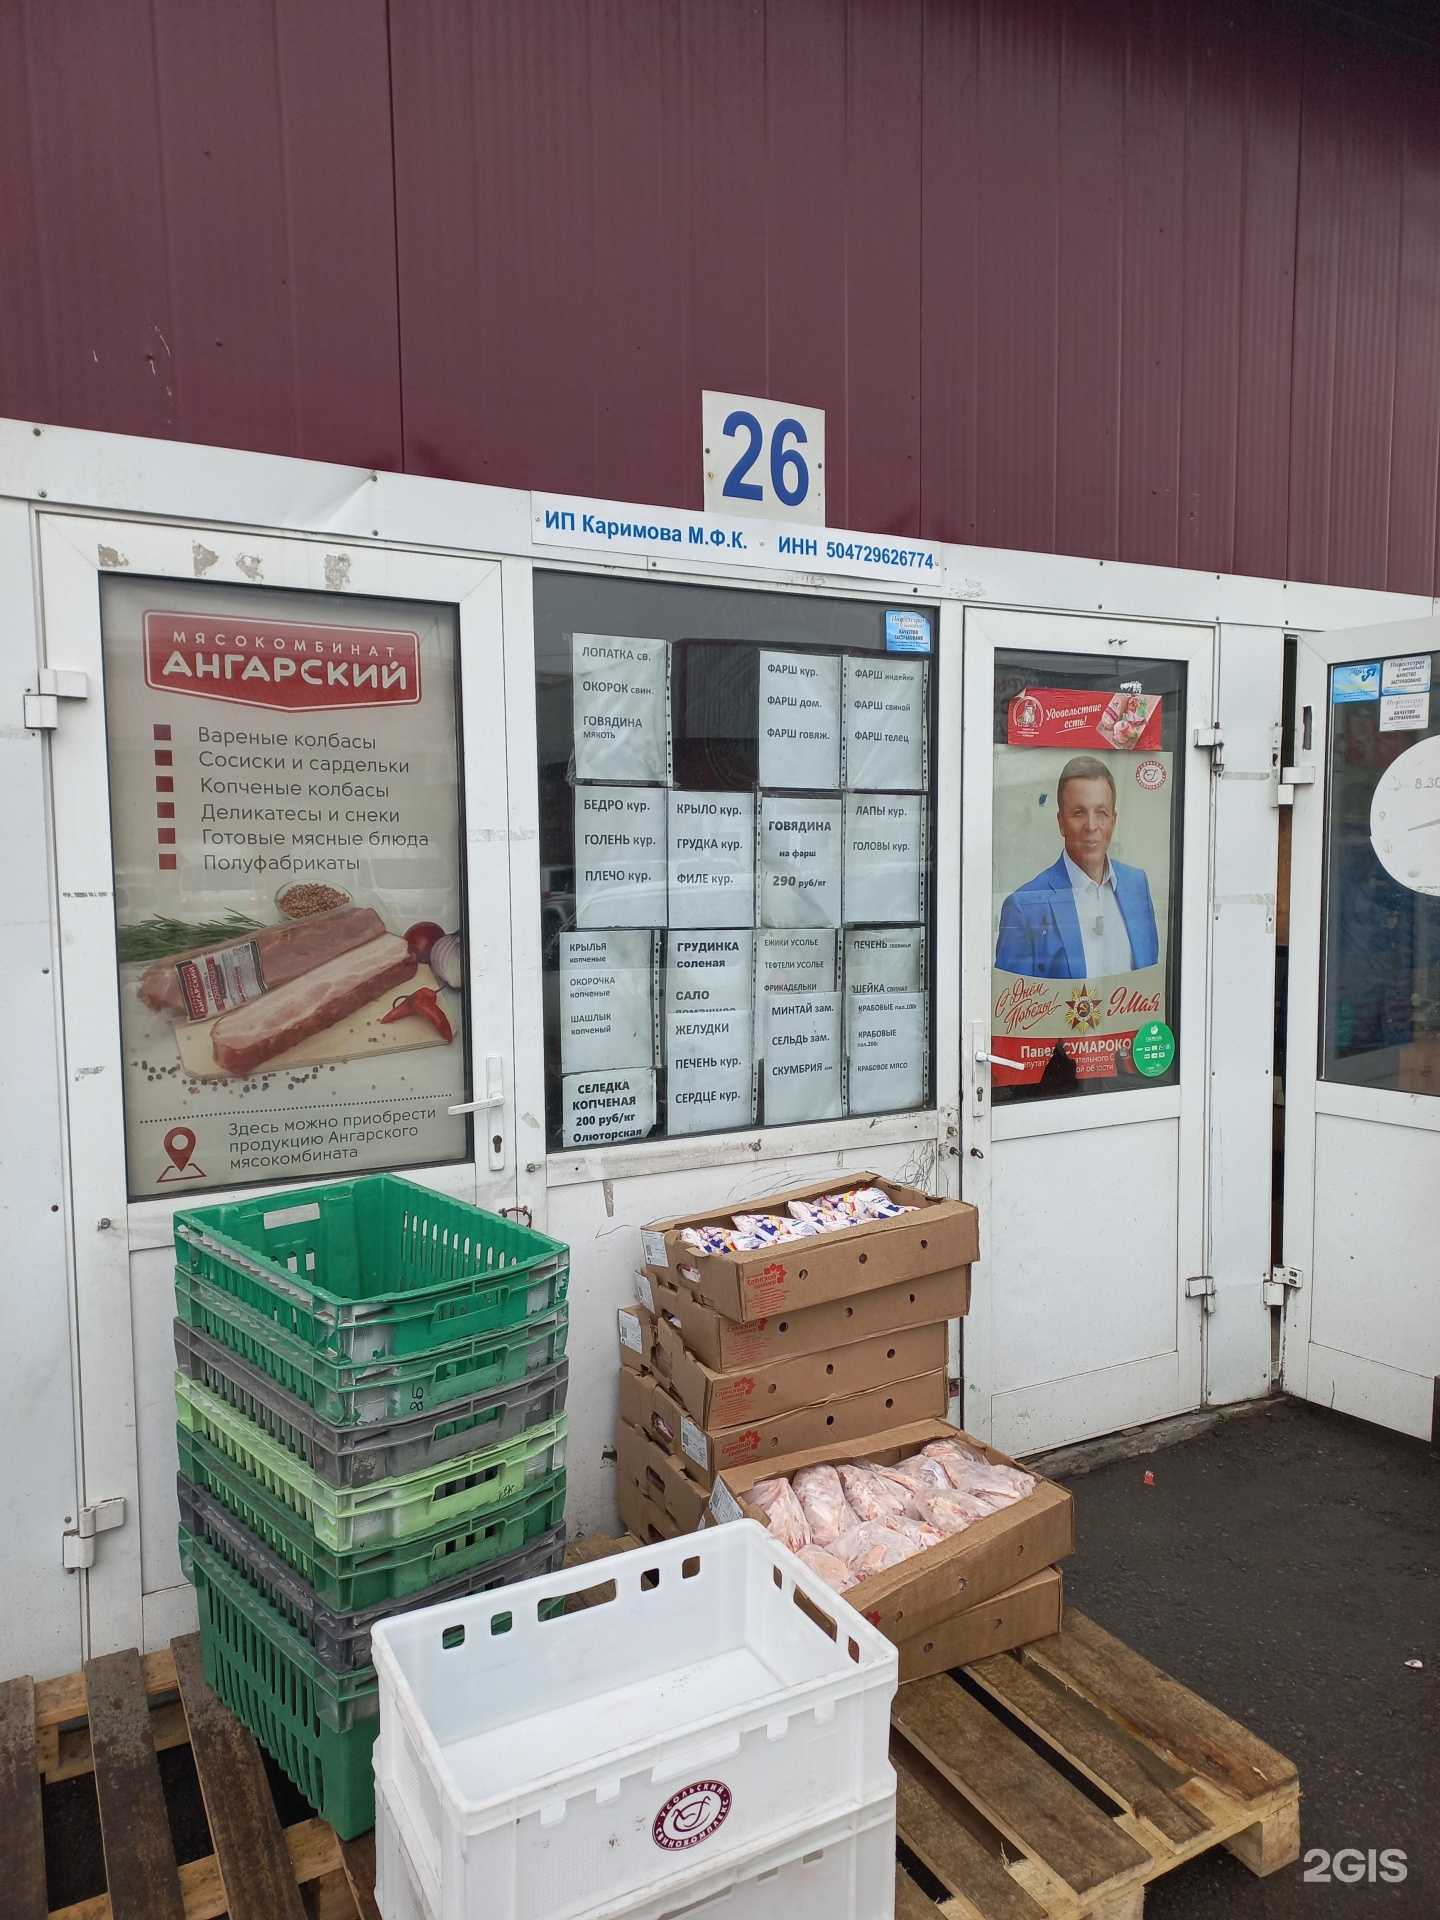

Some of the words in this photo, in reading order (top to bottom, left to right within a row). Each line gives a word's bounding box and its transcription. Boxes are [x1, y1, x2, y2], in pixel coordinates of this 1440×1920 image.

[722, 410, 809, 507] 26
[545, 510, 575, 531] ИП
[582, 513, 682, 544] Каримова
[688, 525, 748, 550] М.Ф.К.
[778, 536, 817, 557] ИНН
[826, 541, 934, 569] 504729626774
[173, 631, 395, 658] МЯСОКОМБИНАТ
[582, 647, 634, 660] ЛОПАТКА
[162, 650, 407, 690] АНГАРСКИЙ
[767, 663, 798, 674] ФАРШ
[800, 668, 818, 678] кур.
[854, 669, 883, 680] ФАРШ
[583, 681, 628, 694] ОКОРОК
[630, 687, 655, 695] свин.
[767, 696, 797, 707] ФАРШ
[799, 701, 822, 709] дом.
[854, 700, 883, 710] ФАРШ
[583, 716, 643, 729] ГОВЯДИНА
[198, 726, 288, 748] Вареные
[294, 733, 376, 750] колбасы
[583, 731, 616, 740] мякоть
[767, 728, 797, 739] ФАРШ
[799, 732, 831, 740] говяж.
[854, 730, 882, 741] ФАРШ
[884, 735, 910, 744] телец
[199, 751, 285, 769] Сосиски
[292, 757, 303, 770] и
[309, 758, 409, 774] сардельки
[201, 777, 301, 796] Копченые
[308, 781, 389, 798] колбасы
[583, 800, 623, 812] БЕДРО
[626, 802, 650, 813] кур.
[676, 803, 717, 815] КРЫЛО
[720, 806, 742, 817] кур.
[856, 806, 886, 816] ЛАПЫ
[888, 808, 908, 818] кур.
[201, 804, 322, 824] Деликатесы
[328, 810, 339, 822] и
[345, 809, 400, 823] снеки
[768, 821, 832, 834] ГОВЯДИНА
[202, 829, 285, 846] Готовые
[292, 832, 363, 847] мясные
[368, 831, 429, 849] блюда
[584, 834, 630, 845] ГОЛЕНЬ
[633, 836, 656, 848] кур.
[677, 838, 718, 851] ГРУДКА
[721, 840, 743, 851] кур.
[853, 841, 890, 851] ГОЛОВЫ
[892, 843, 910, 852] кур.
[792, 849, 817, 859] фарш
[204, 854, 360, 875] Полуфабрикаты
[585, 870, 625, 881] ПЛЕЧО
[628, 872, 651, 883] кур.
[677, 873, 709, 884] ФИЛЕ
[711, 875, 734, 886] кур.
[772, 875, 796, 887] 290
[798, 879, 827, 889] руб/кг
[569, 942, 607, 952] КРЫЛЬЯ
[677, 941, 739, 953] ГРУДИНКА
[853, 940, 888, 949] ПЕЧЕНЬ
[569, 955, 607, 963] копченые
[676, 960, 726, 968] соленая
[764, 961, 795, 969] ТЕФТЕЛИ
[797, 960, 824, 969] УСОЛЬЕ
[569, 976, 616, 986] ОКОРОЧКА
[763, 983, 817, 992] ФРИКАДЕЛЬКИ
[852, 982, 885, 993] ШЕЙКА
[570, 989, 611, 998] копченые
[675, 990, 710, 1001] САЛО
[771, 1002, 813, 1016] МИНТАЙ
[814, 1005, 834, 1013] зам.
[858, 1003, 895, 1012] КРАБОВЫЕ
[571, 1013, 612, 1023] ШАШЛЫК
[571, 1024, 612, 1036] копченый
[675, 1023, 729, 1036] ЖЕЛУДКИ
[858, 1029, 897, 1038] КРАБОВЫЕ
[772, 1035, 808, 1046] СЕЛЬДЬ
[810, 1033, 830, 1043] зам.
[1020, 1045, 1056, 1059] Паве
[1062, 1038, 1133, 1055] СУМАРОКО
[675, 1057, 717, 1070] ПЕЧЕНЬ
[720, 1055, 741, 1067] кур.
[857, 1063, 889, 1072] КРАБОВОЕ
[889, 1062, 908, 1070] МЯСО
[772, 1063, 823, 1076] СКУМБРИЯ
[577, 1080, 630, 1094] СЕЛЕДКА
[572, 1095, 636, 1110] КОПЧЕНАЯ
[675, 1091, 717, 1105] СЕРДЦЕ
[719, 1089, 741, 1101] кур.
[228, 1122, 279, 1137] Здесь
[284, 1116, 338, 1131] можно
[343, 1107, 436, 1128] приобрести
[576, 1115, 596, 1127] 200
[599, 1112, 636, 1127] руб/кг
[229, 1134, 324, 1154] продукцию
[328, 1124, 418, 1145] Ангарского
[573, 1128, 642, 1143] Олюторская
[230, 1147, 359, 1170] мясокомбината
